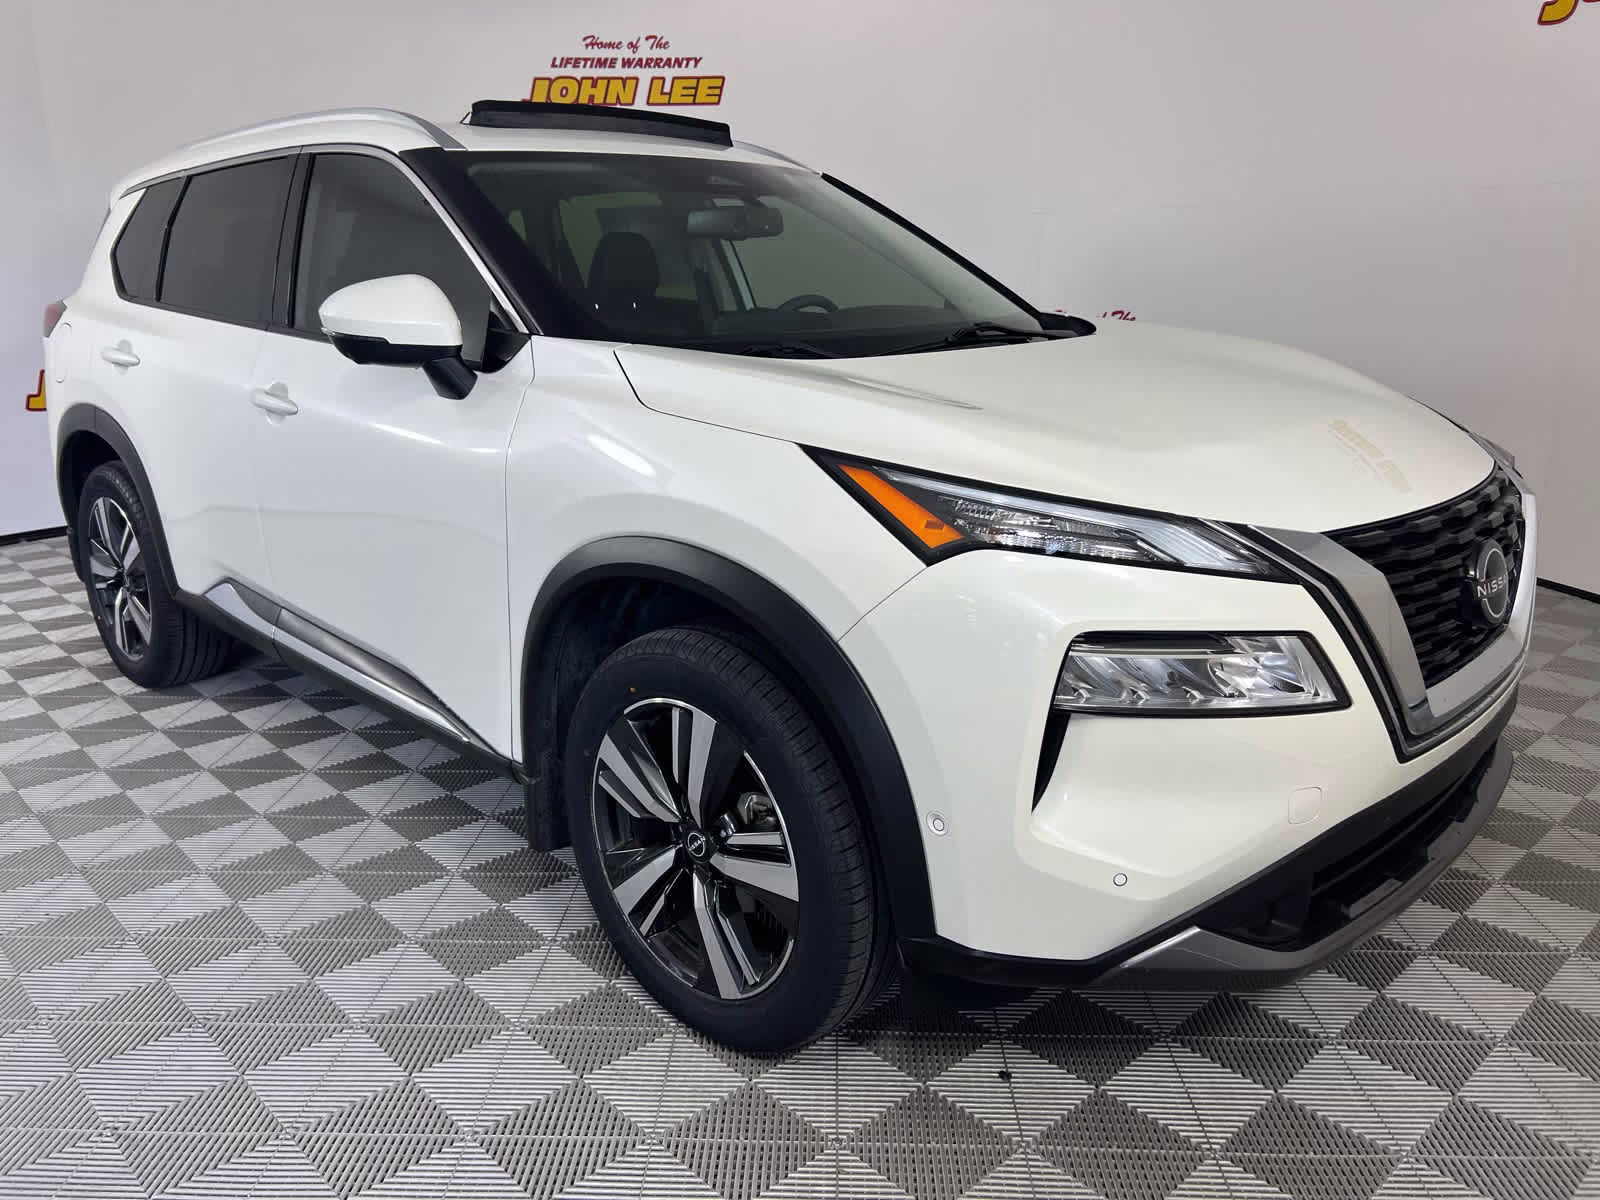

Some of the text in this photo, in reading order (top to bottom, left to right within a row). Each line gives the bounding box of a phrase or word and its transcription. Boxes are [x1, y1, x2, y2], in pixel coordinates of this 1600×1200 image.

[582, 35, 670, 54] Home of The
[550, 57, 703, 69] LIFETIME WARRANTY
[521, 75, 726, 106] JOHN LEE
